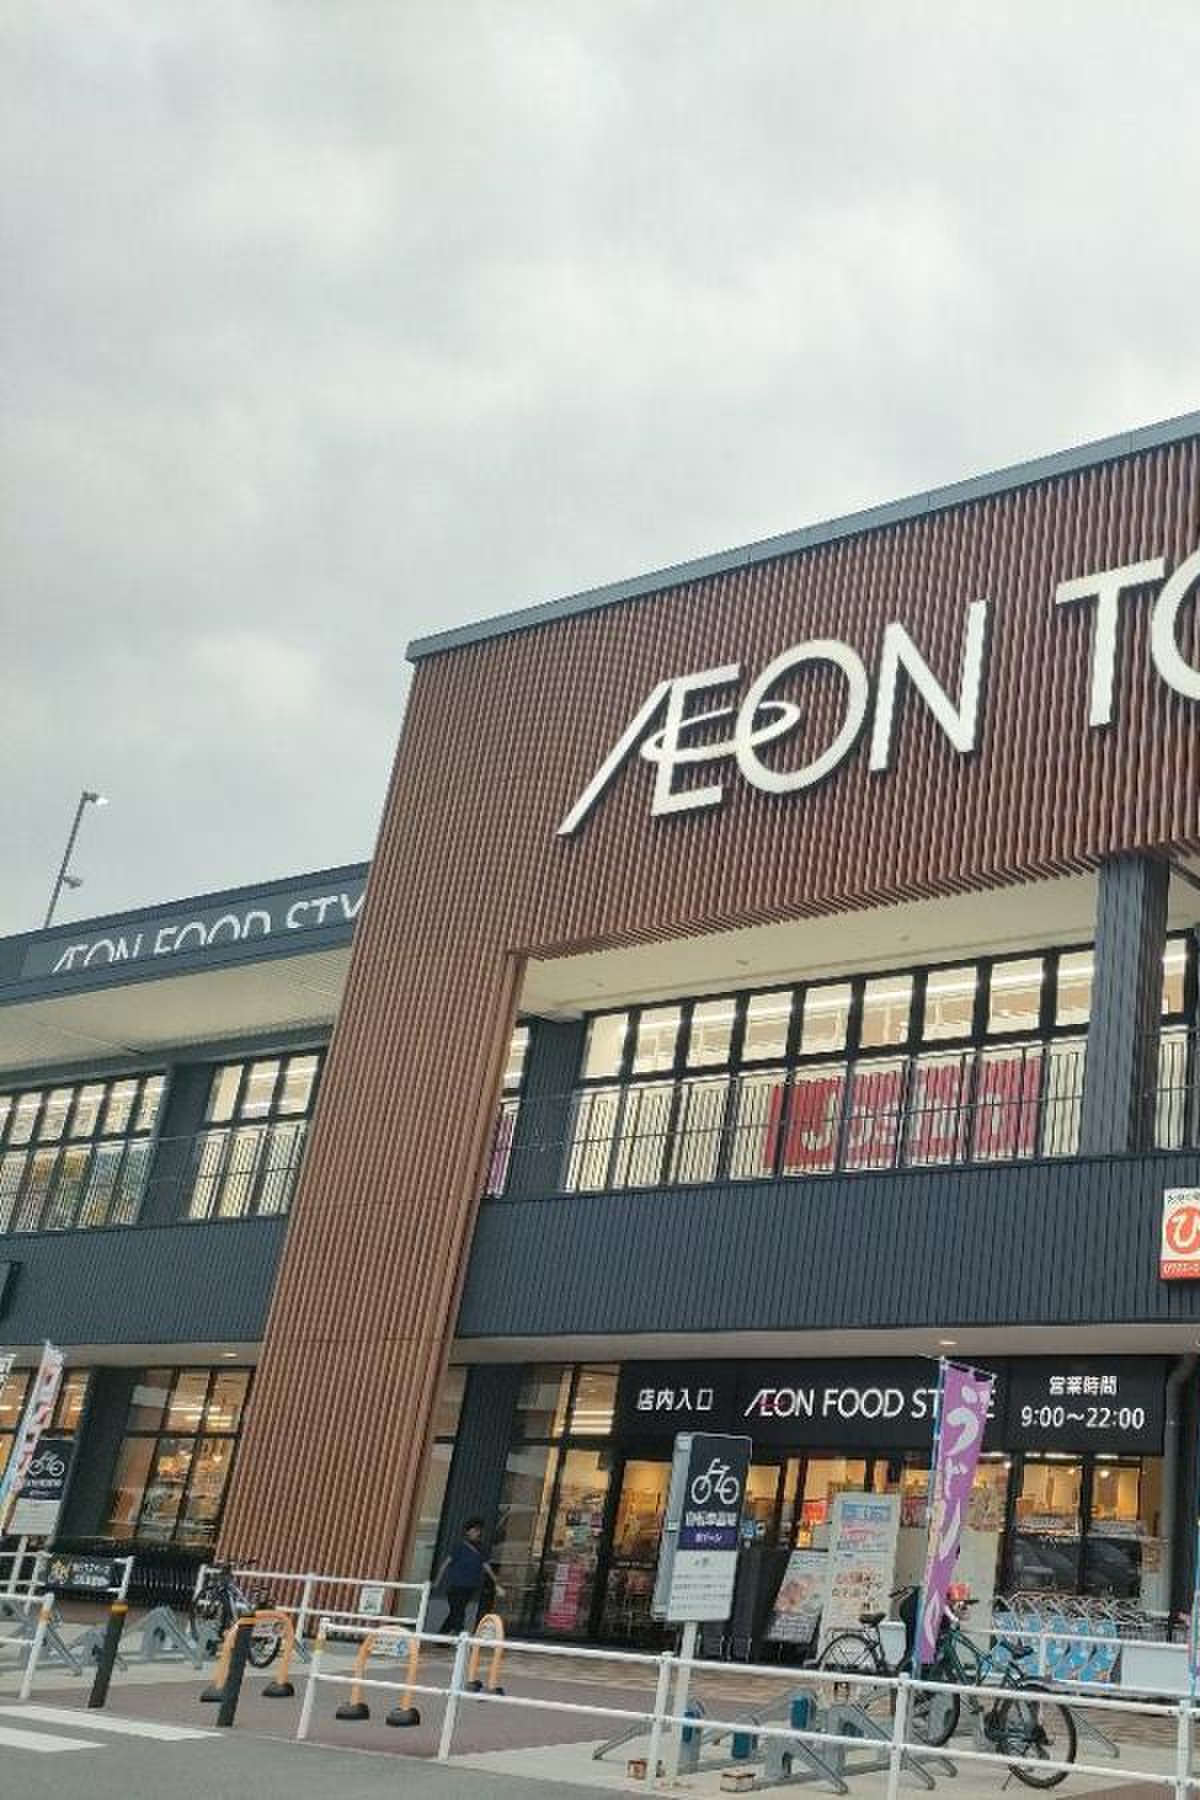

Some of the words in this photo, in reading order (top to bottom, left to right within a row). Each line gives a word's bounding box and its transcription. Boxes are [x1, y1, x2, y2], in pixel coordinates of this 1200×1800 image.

[1049, 1375, 1118, 1397] 営業時間
[636, 1387, 714, 1411] 店内入口
[822, 1388, 905, 1418] FOOD
